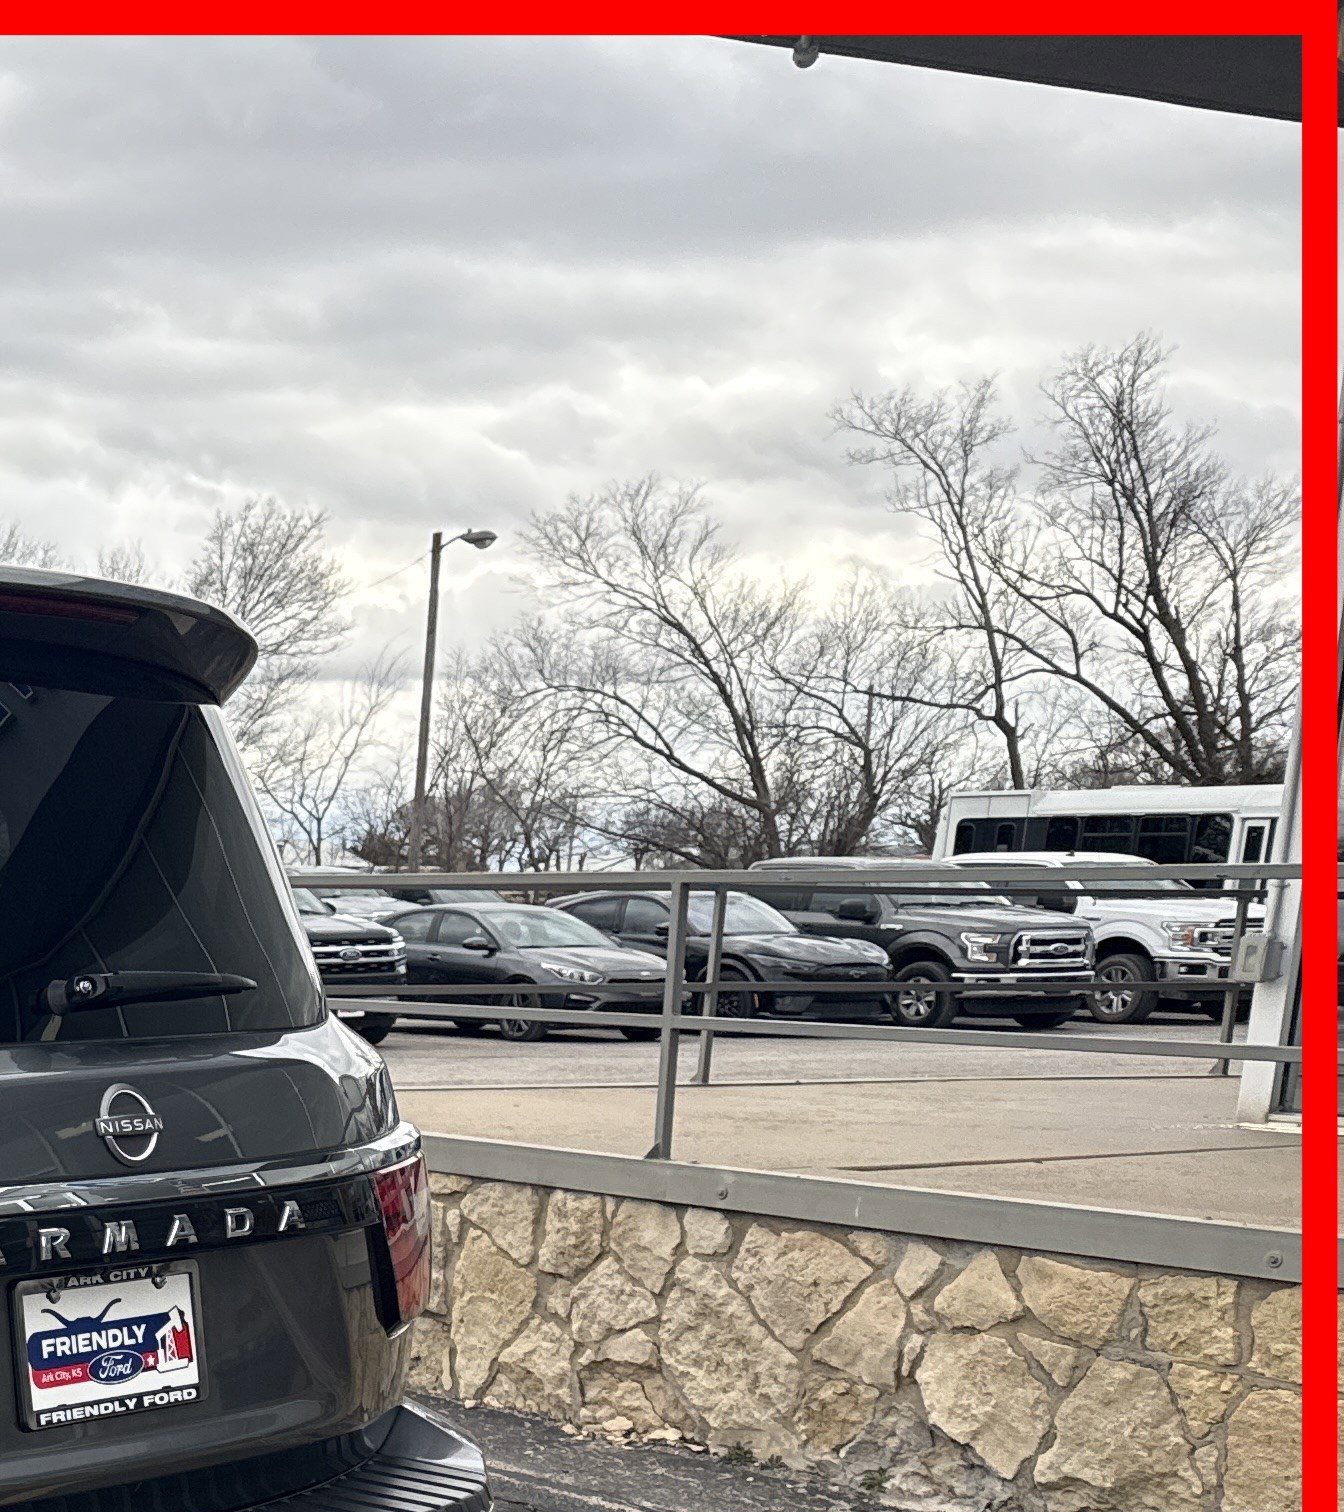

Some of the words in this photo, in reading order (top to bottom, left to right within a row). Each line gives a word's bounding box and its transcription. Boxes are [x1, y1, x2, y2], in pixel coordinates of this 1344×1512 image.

[100, 1116, 163, 1134] NISSAN
[66, 1275, 105, 1288] ARK
[109, 1266, 149, 1282] CITY
[40, 1323, 146, 1359] FRIENDLY
[98, 1354, 133, 1379] Ford
[39, 1396, 138, 1427] FRIENDLY
[142, 1387, 198, 1408] FORD
